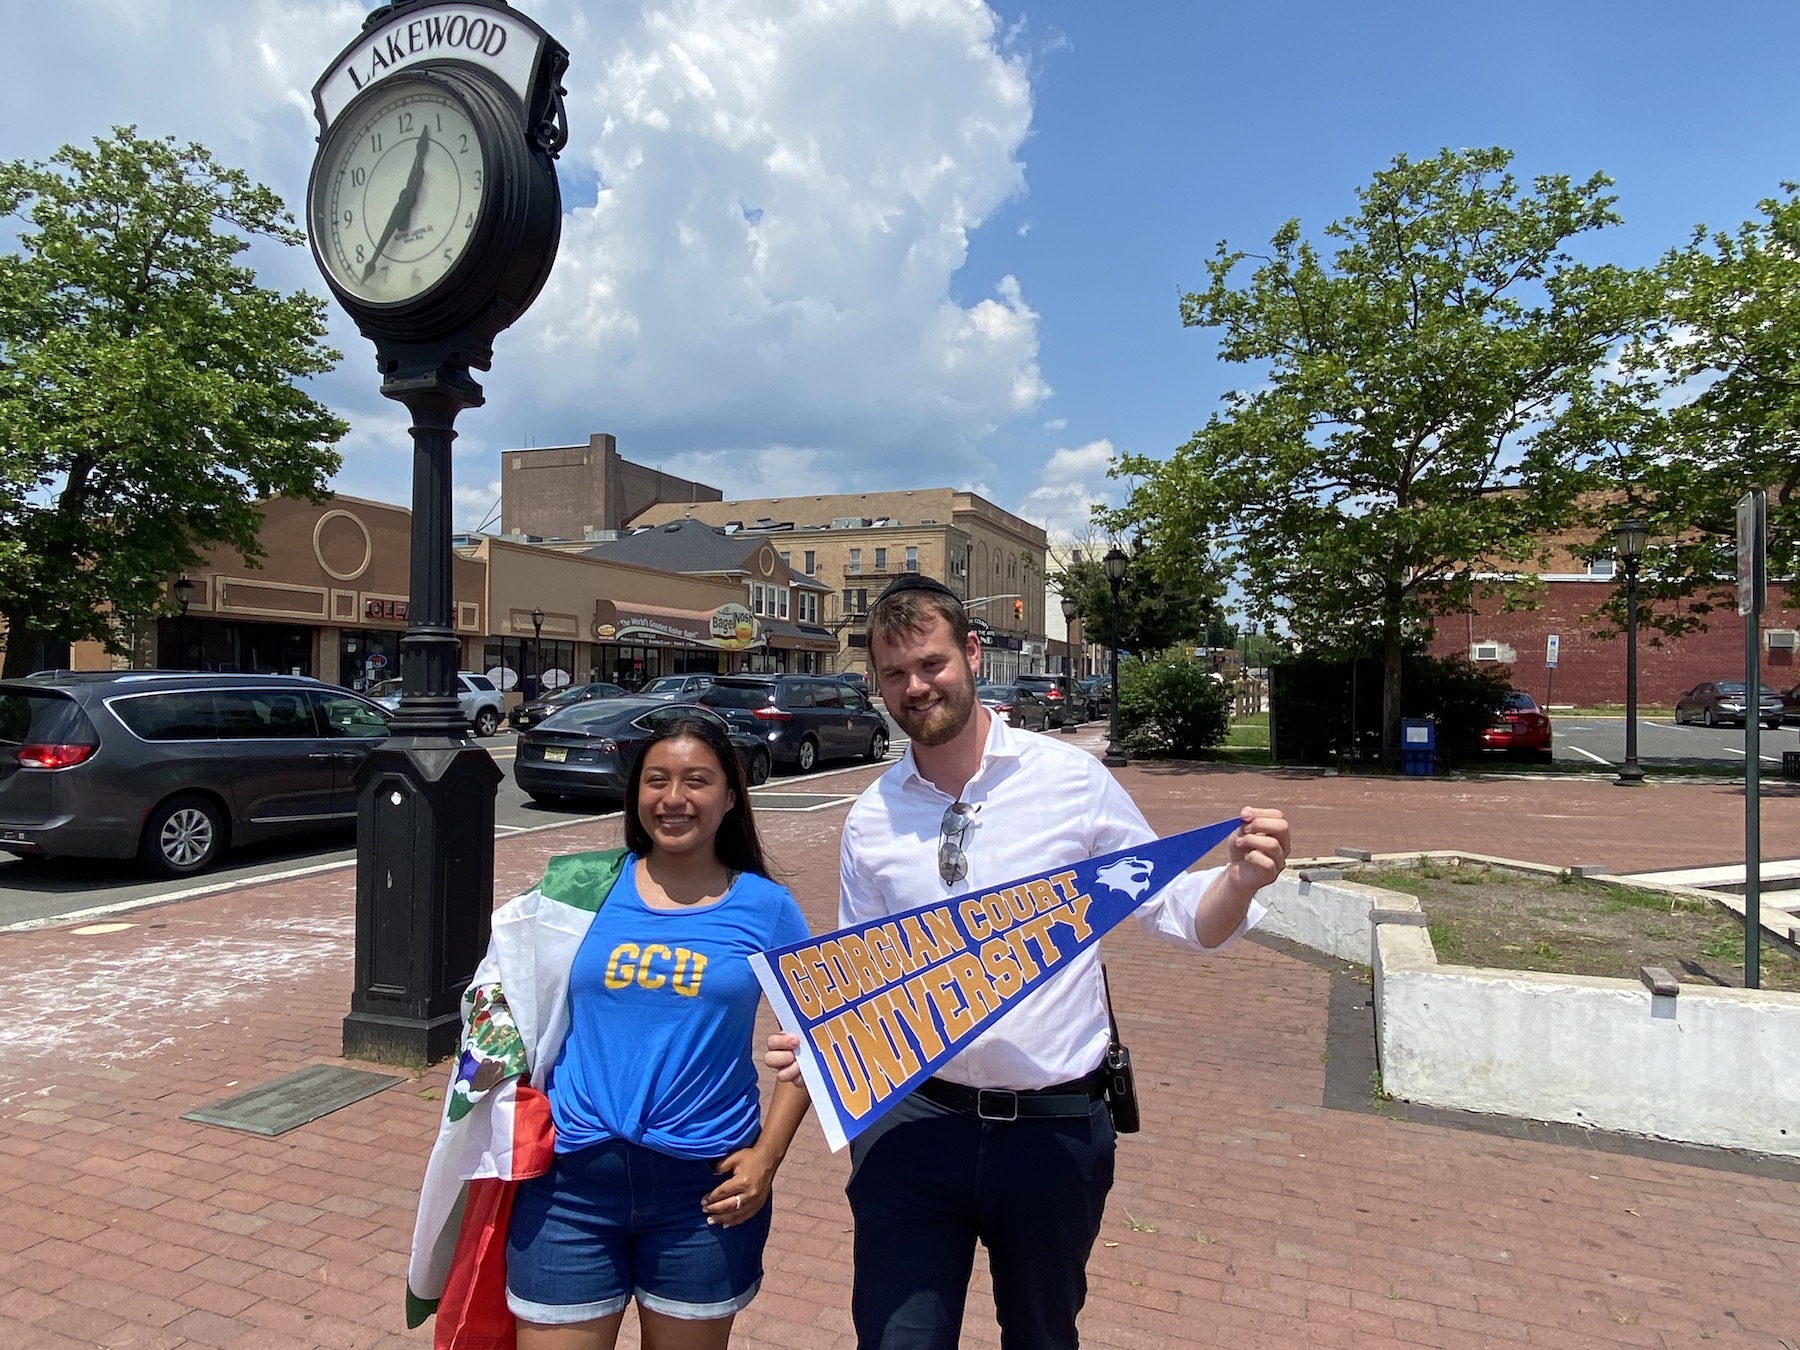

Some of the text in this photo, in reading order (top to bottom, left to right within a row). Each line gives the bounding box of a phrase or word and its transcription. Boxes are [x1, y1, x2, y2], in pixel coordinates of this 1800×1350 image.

[347, 15, 507, 91] LAKEWOOD
[397, 112, 414, 135] 12
[435, 113, 443, 133] 1
[370, 133, 383, 154] 11
[458, 133, 468, 154] 2
[351, 167, 366, 188] 10
[474, 170, 482, 190] 3
[344, 210, 353, 229] 9
[465, 212, 474, 229] 4
[355, 244, 365, 264] 8
[443, 248, 453, 263] 5
[380, 266, 392, 283] 7
[411, 267, 421, 287] 6
[712, 612, 736, 634] Bagel
[735, 610, 753, 627] Nosh
[778, 870, 1079, 1021] GEORGIAN COURT
[604, 943, 708, 998] GCU
[809, 894, 1093, 1120] UNIVERSITY
